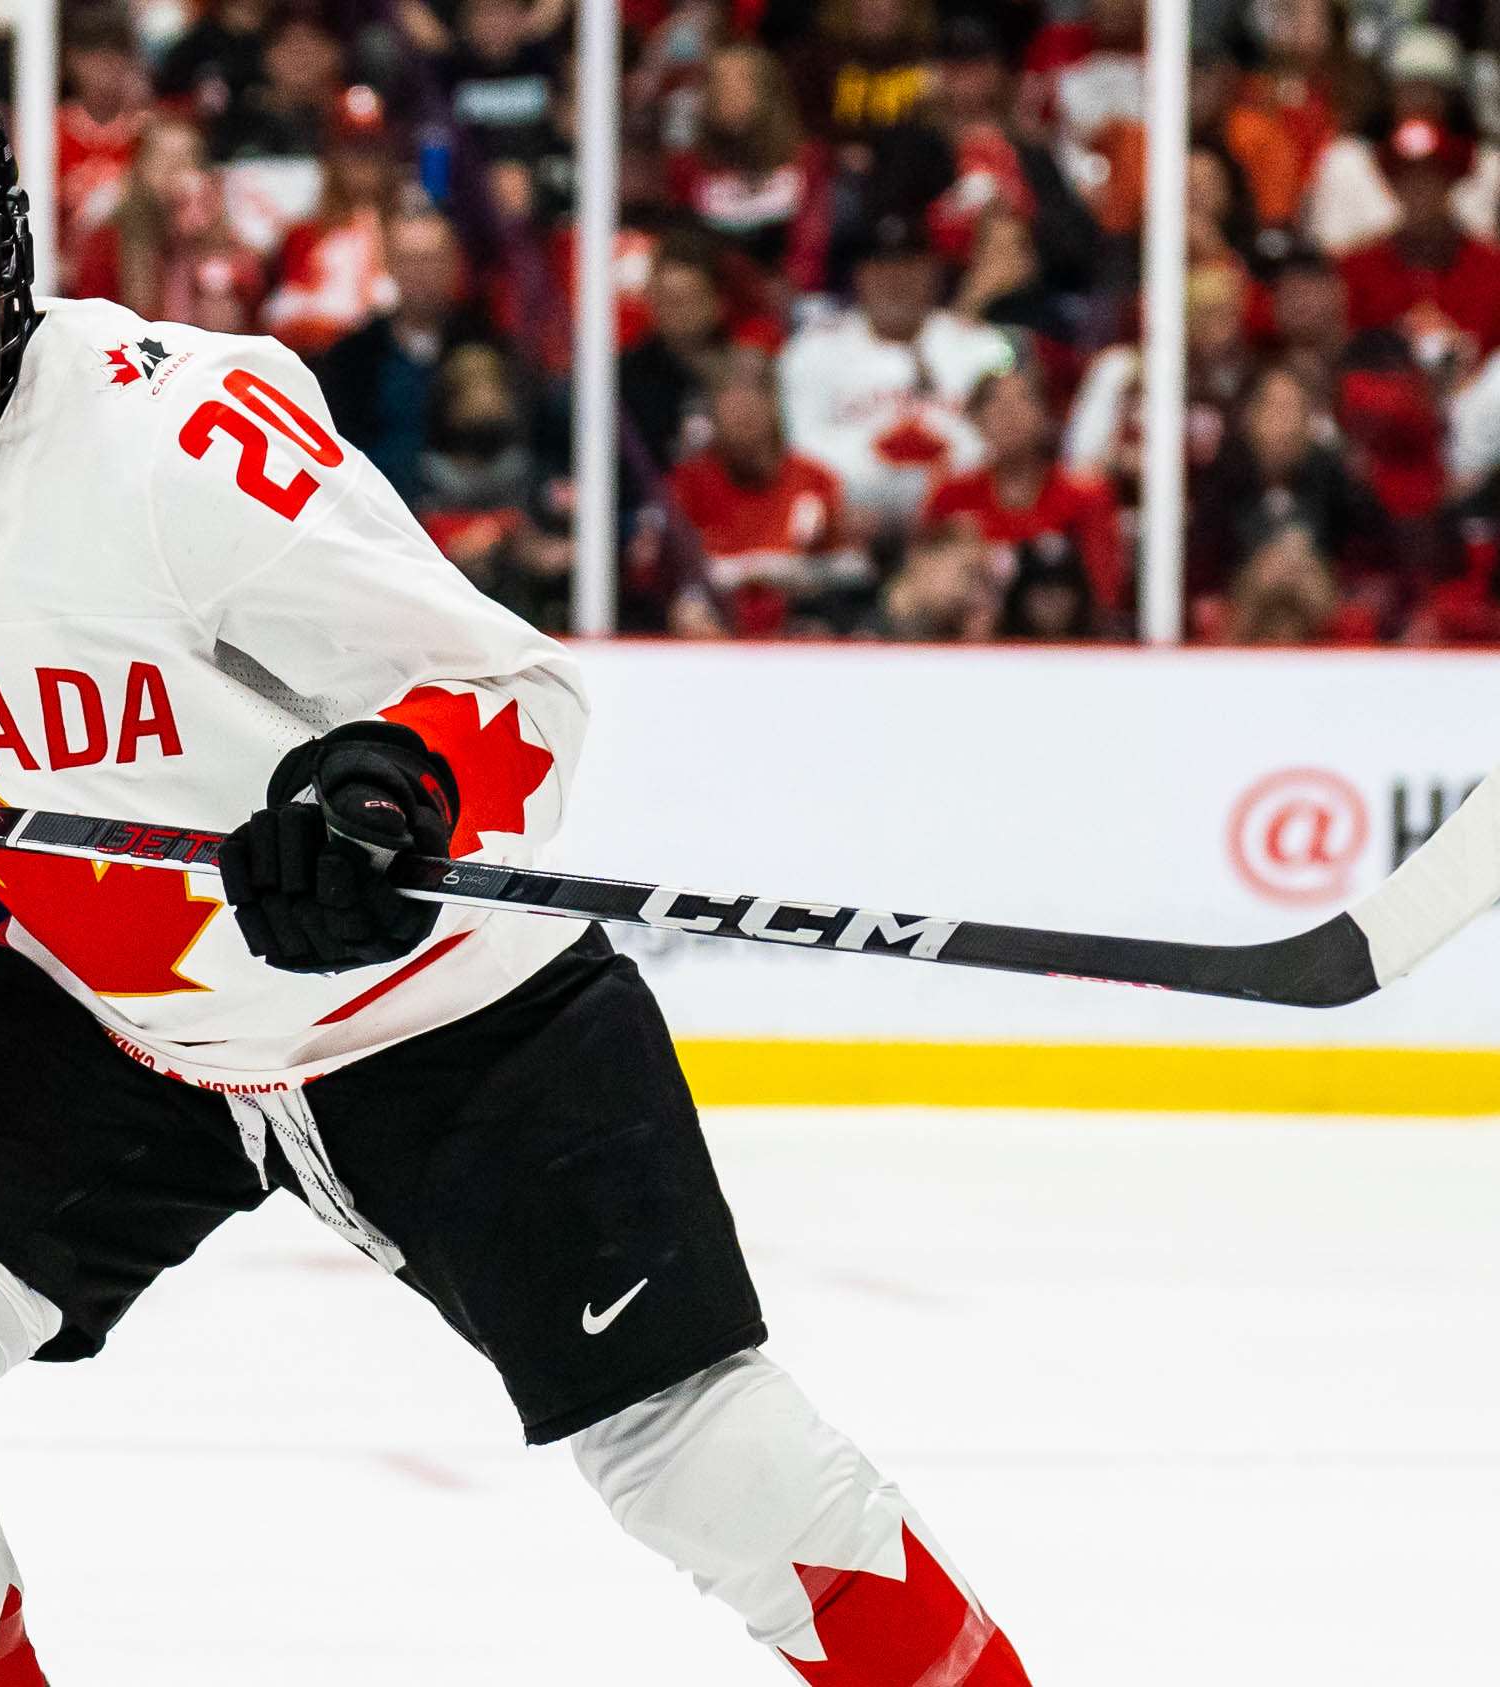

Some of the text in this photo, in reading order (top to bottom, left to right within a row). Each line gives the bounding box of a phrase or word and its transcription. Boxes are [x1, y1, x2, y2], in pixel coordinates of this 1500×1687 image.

[151, 351, 194, 396] CANADA
[179, 368, 344, 521] 20
[96, 822, 227, 867] JET
[637, 886, 963, 963] CCM
